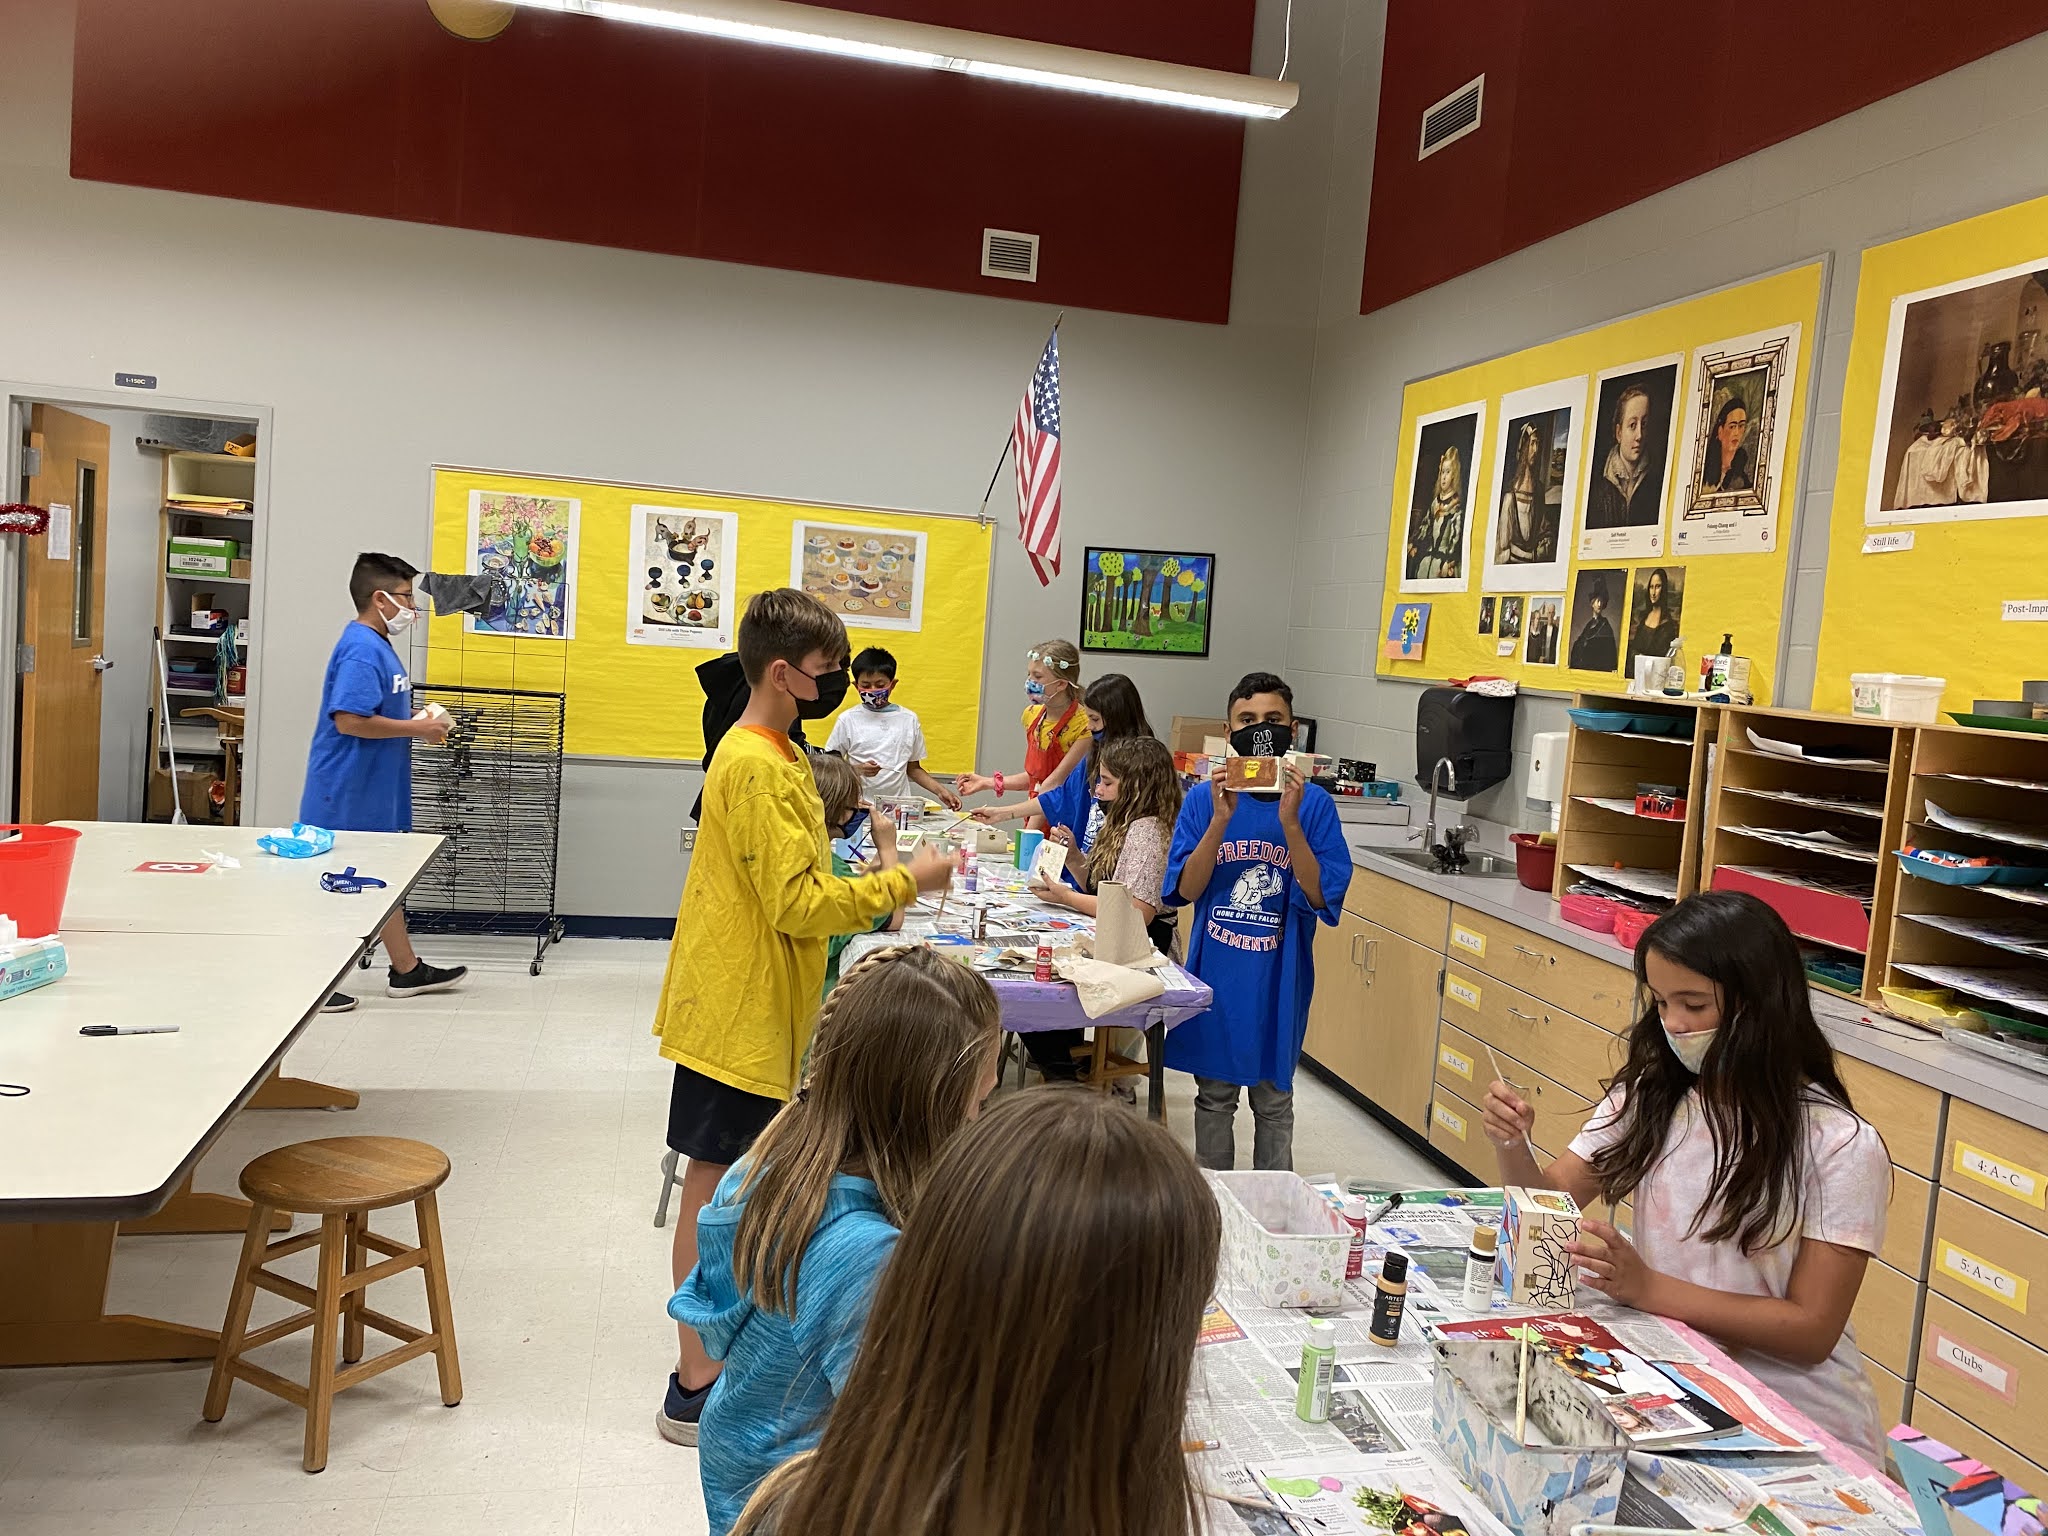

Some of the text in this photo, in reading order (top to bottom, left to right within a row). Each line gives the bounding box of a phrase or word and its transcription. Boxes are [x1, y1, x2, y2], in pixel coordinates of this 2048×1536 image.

[1873, 537, 1899, 546] Still life
[1253, 729, 1273, 743] GOOD
[1253, 742, 1274, 756] VIBES
[1216, 909, 1234, 918] HOME
[1235, 910, 1245, 919] OF
[1246, 911, 1258, 921] THE
[1977, 1160, 1987, 1174] 4:
[1960, 1258, 1971, 1272] 5:
[1952, 1347, 1983, 1374] Clubs
